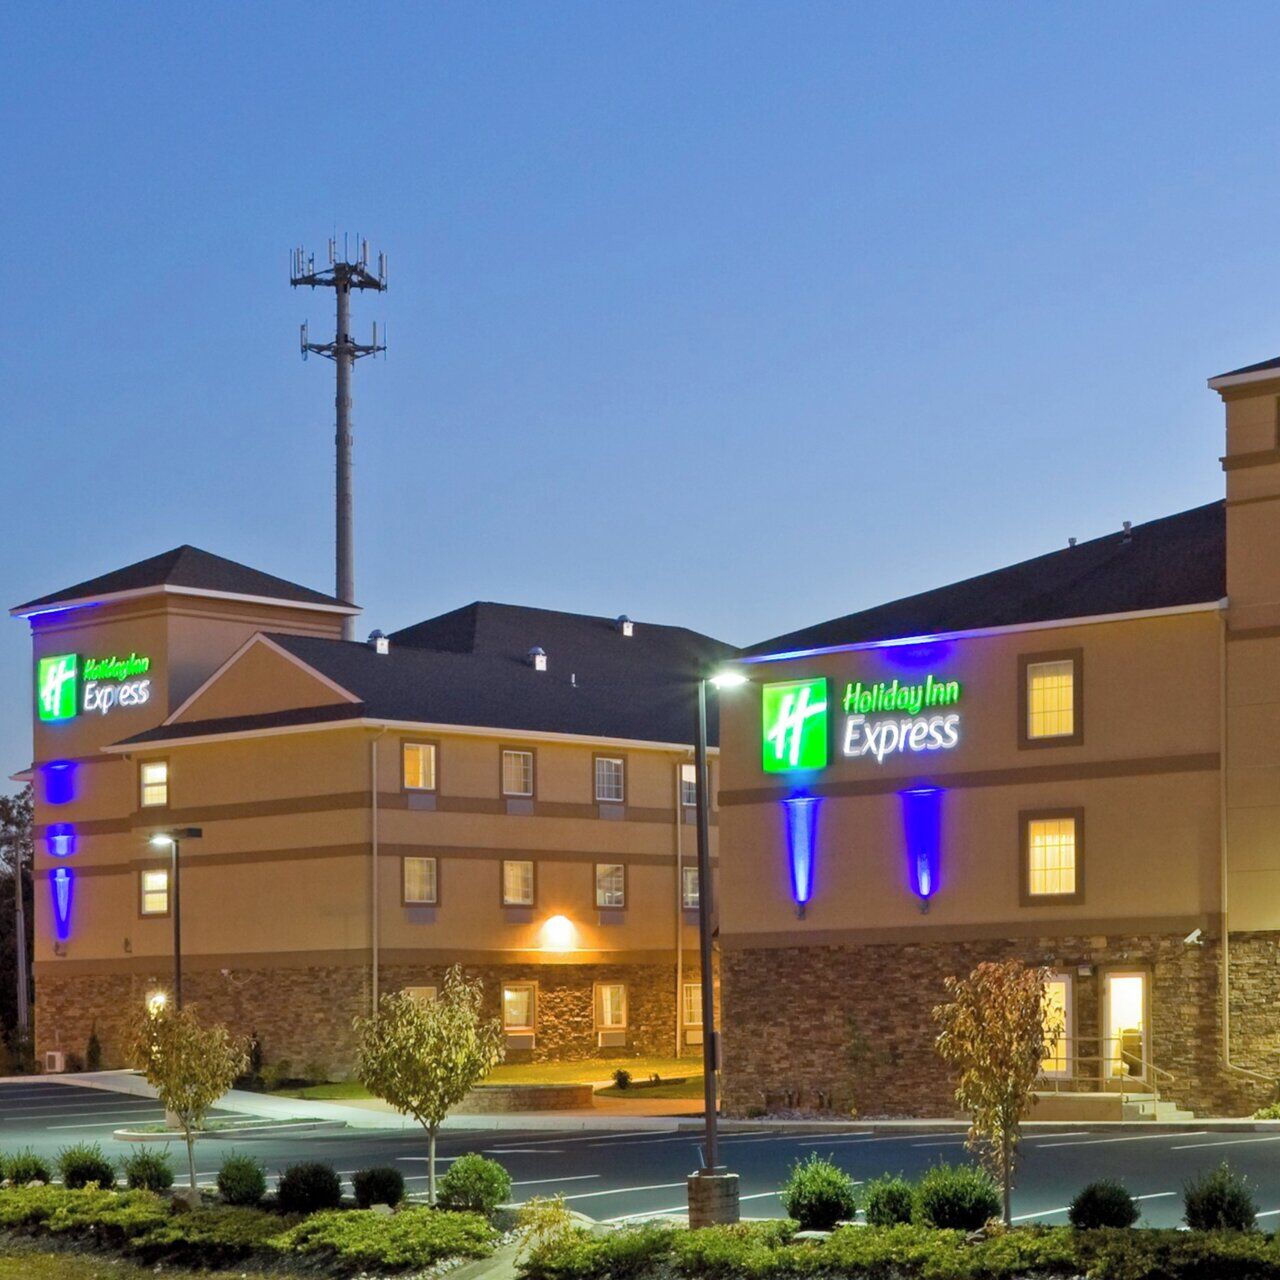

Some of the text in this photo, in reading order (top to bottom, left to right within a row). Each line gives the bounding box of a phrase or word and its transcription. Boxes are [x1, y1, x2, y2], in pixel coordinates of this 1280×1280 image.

[84, 652, 150, 681] Holiday Inn
[83, 679, 151, 715] Express
[843, 675, 959, 714] Holiday Inn
[843, 714, 960, 764] Express
